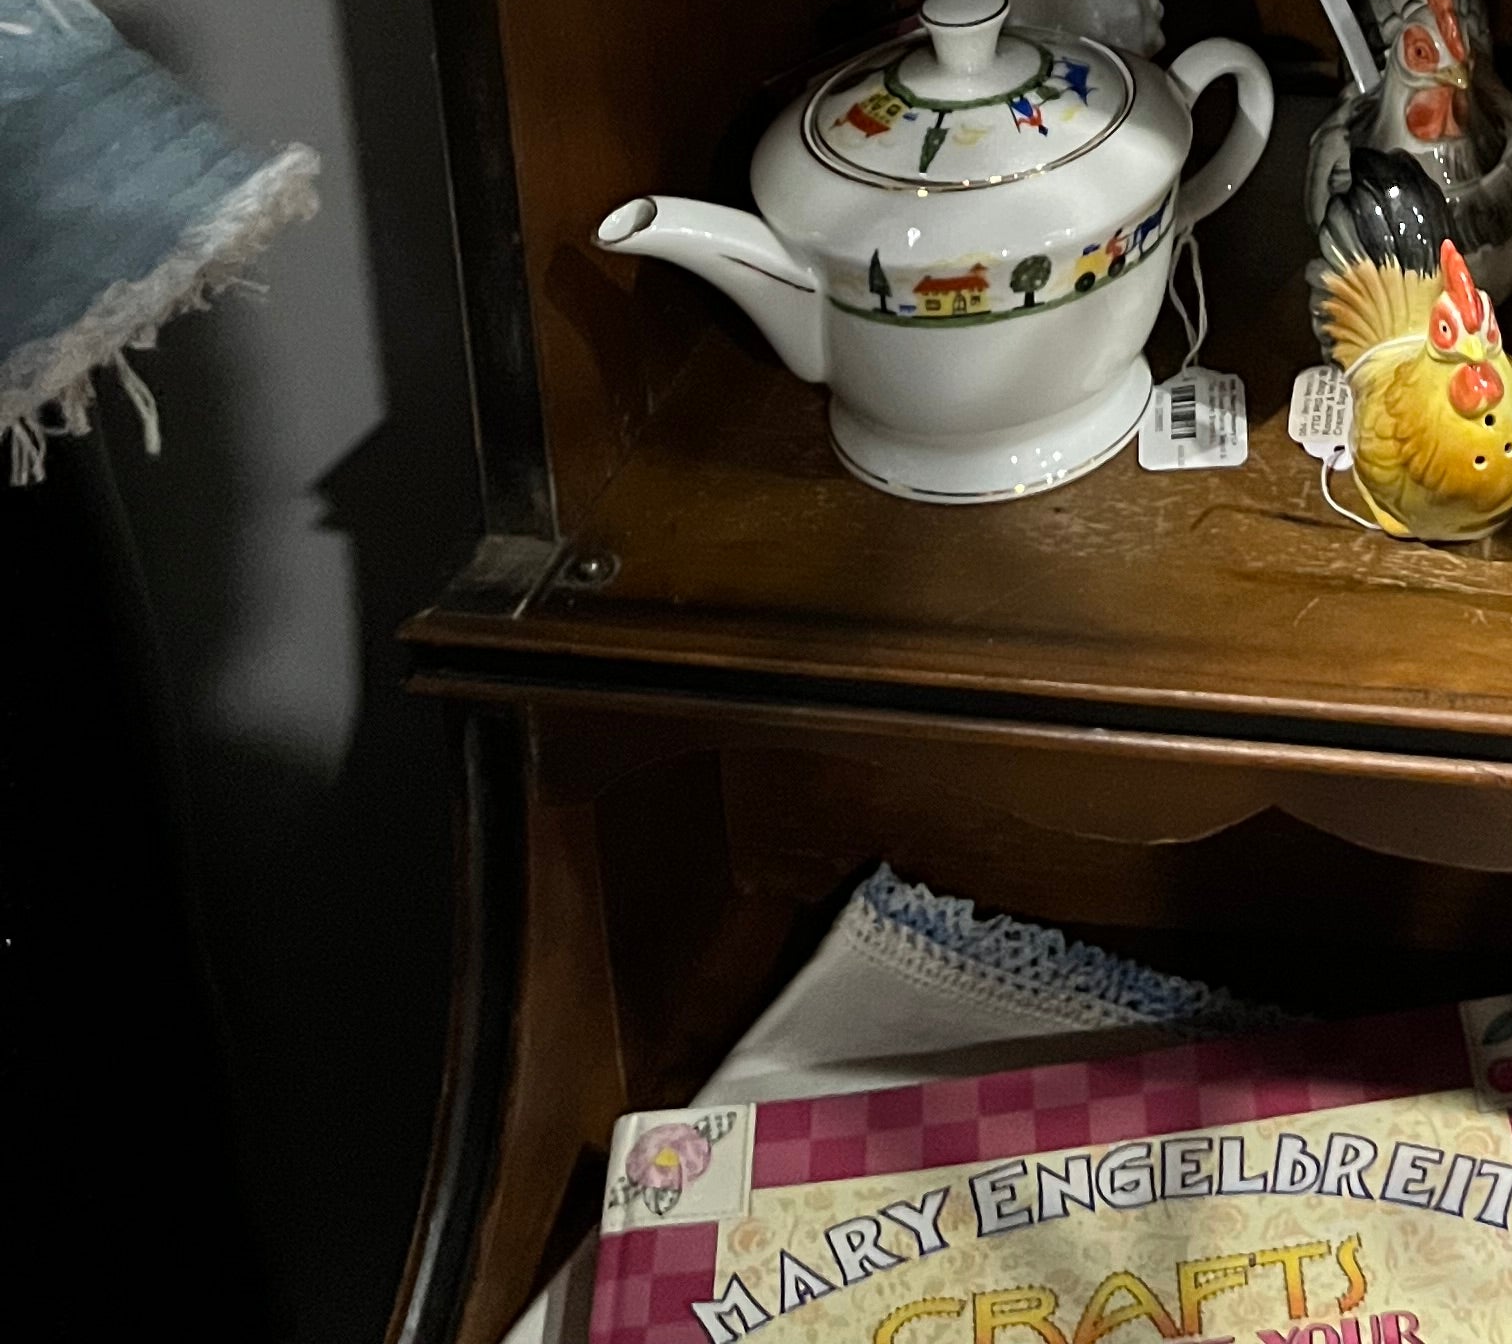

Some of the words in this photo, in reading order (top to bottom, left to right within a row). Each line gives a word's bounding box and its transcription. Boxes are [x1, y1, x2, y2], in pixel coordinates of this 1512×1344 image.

[691, 1186, 951, 1344] MARY
[872, 1232, 1369, 1344] CRAFTS
[1256, 1311, 1425, 1344] OUR
